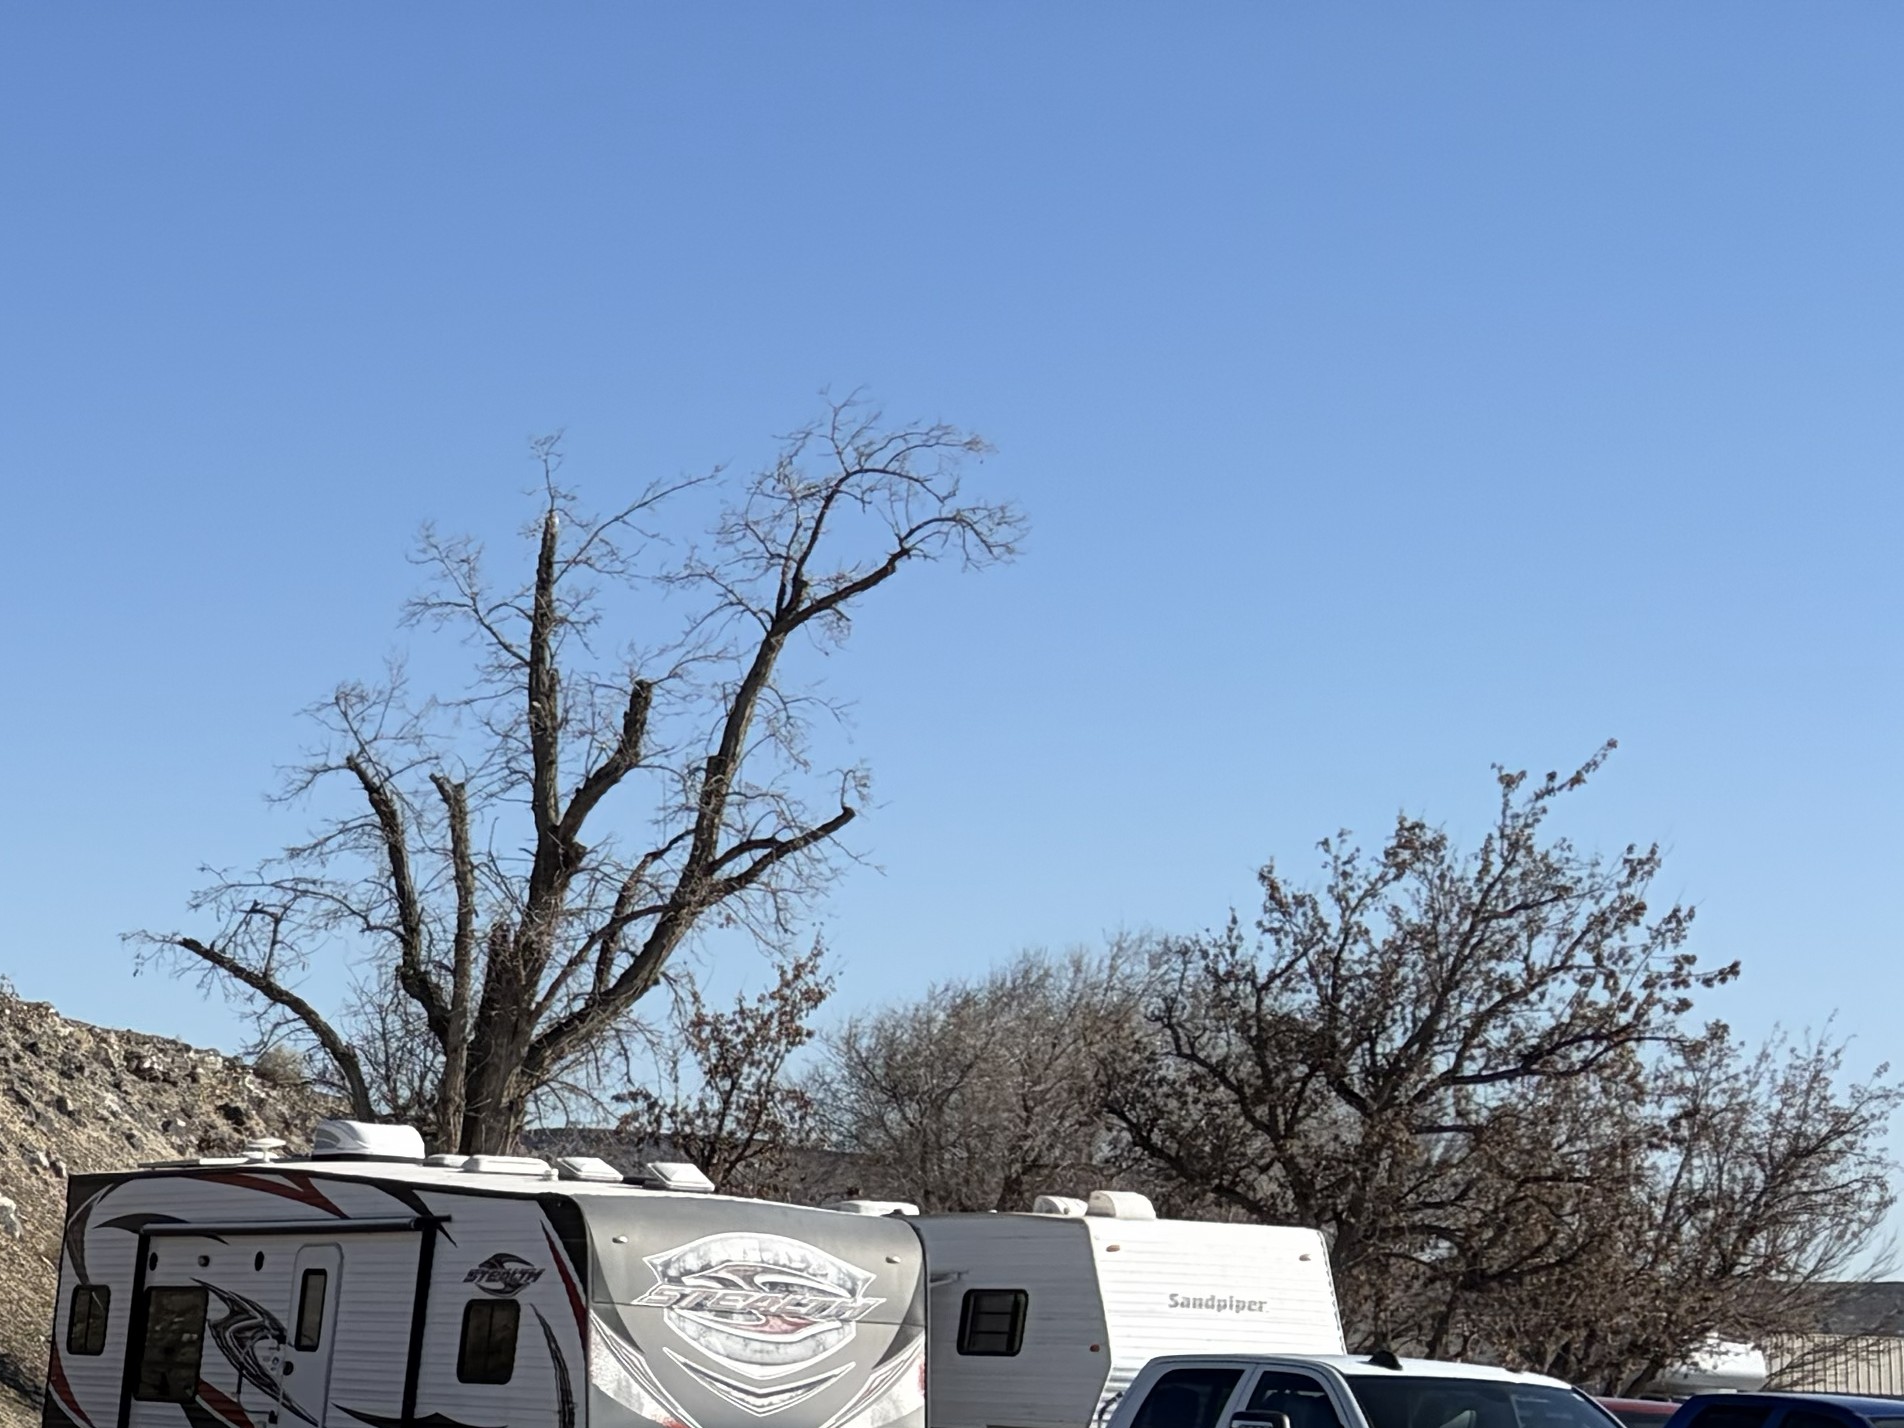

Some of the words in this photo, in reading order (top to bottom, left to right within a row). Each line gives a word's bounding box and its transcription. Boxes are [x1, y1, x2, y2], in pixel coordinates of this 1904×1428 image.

[463, 1268, 546, 1283] STEALTH
[631, 1284, 888, 1323] STEALTH
[1168, 1293, 1268, 1313] Sandpiper
